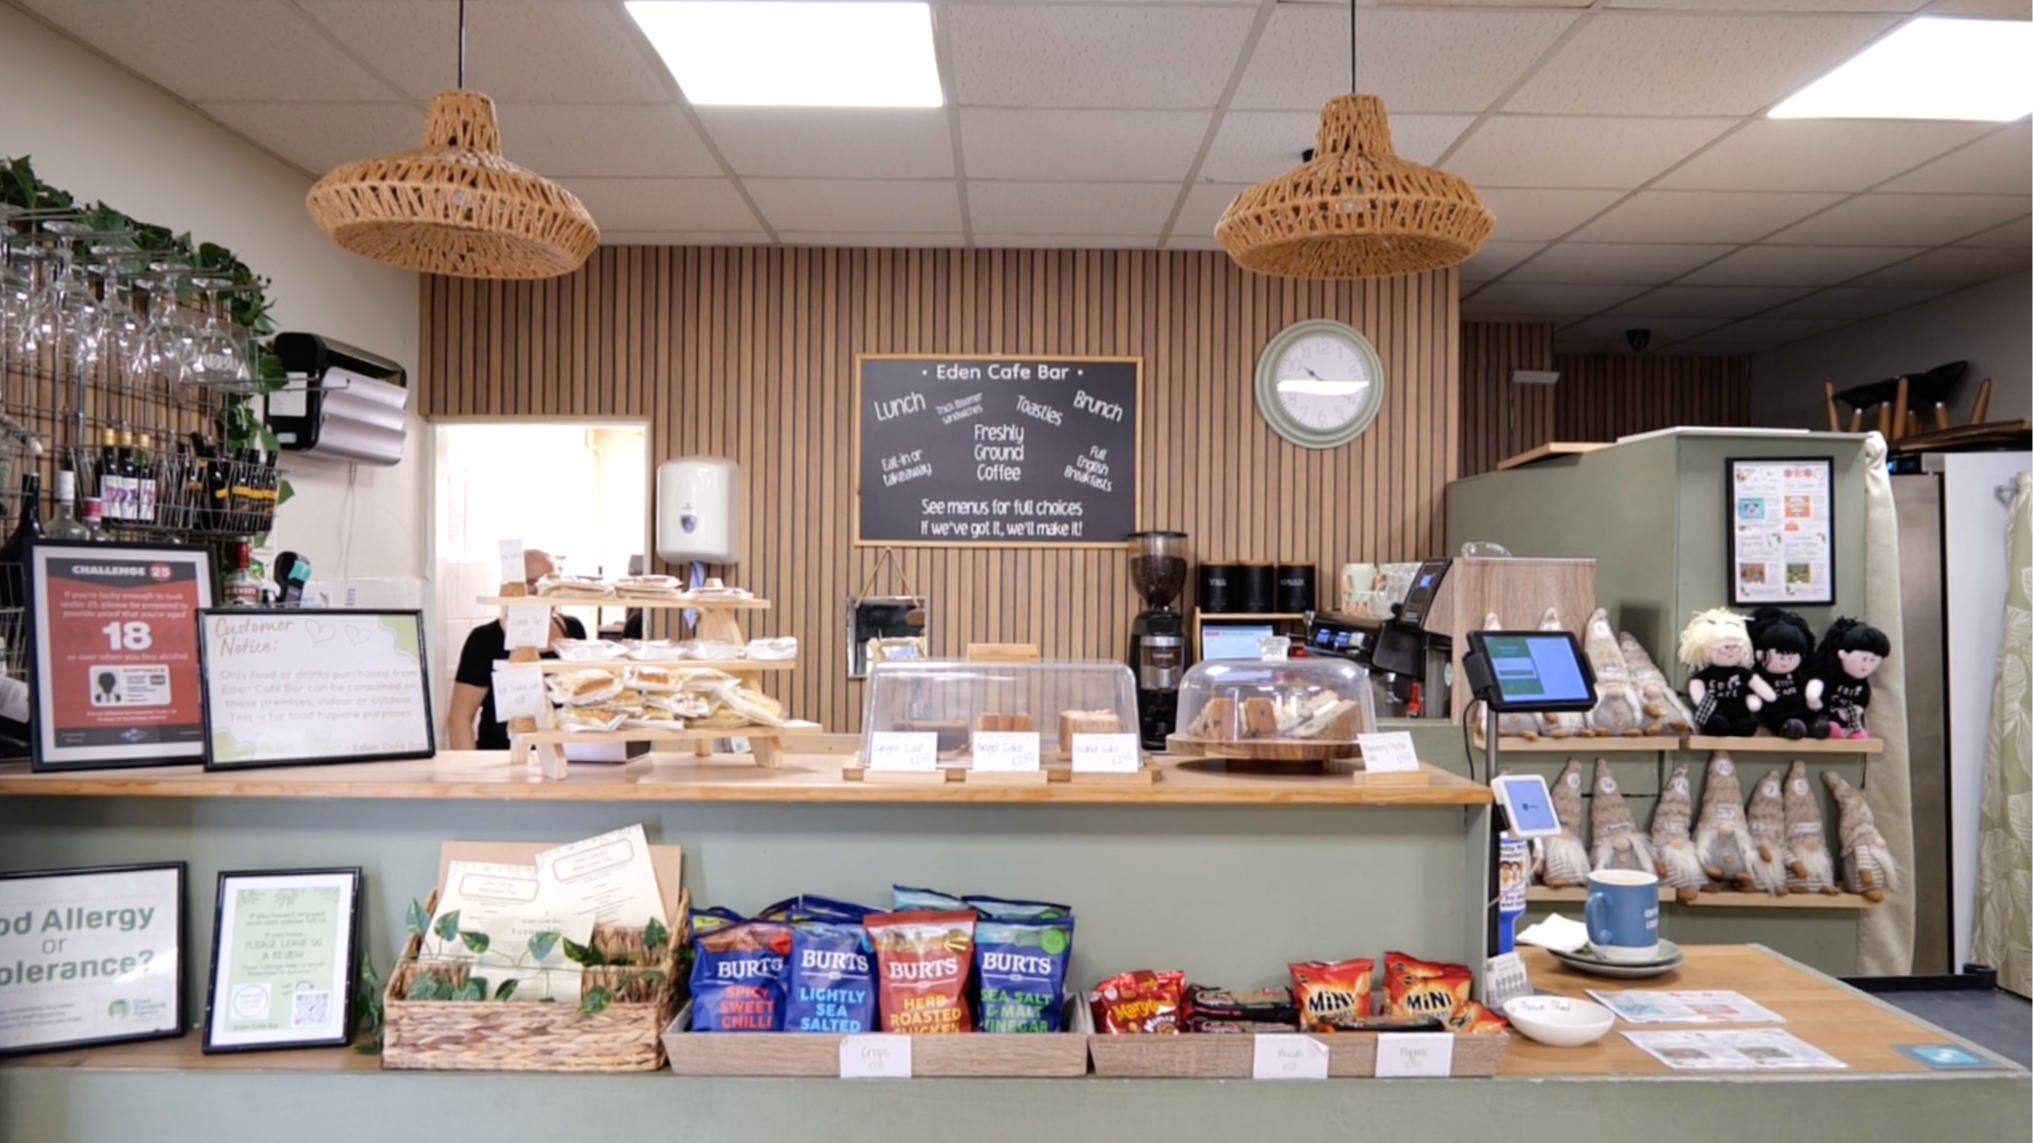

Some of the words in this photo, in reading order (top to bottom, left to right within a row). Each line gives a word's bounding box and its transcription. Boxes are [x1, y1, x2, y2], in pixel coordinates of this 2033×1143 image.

[936, 364, 981, 380] Eden
[988, 364, 1031, 380] Cafe
[1037, 364, 1070, 380] Bar
[874, 391, 926, 422] Lunch
[1016, 394, 1063, 426] Toasties
[1073, 390, 1123, 423] Brunch
[974, 424, 1025, 445] Freshly
[881, 452, 911, 472] Eat-in
[911, 449, 922, 462] or
[974, 444, 1025, 461] Ground
[1090, 445, 1107, 461] Full
[976, 464, 1021, 482] Coffee
[1076, 455, 1109, 476] English
[882, 462, 933, 488] takeaway
[1064, 465, 1113, 492] Breakfasts
[922, 499, 945, 515] See
[947, 500, 989, 516] menus
[992, 499, 1011, 515] for
[1014, 499, 1034, 515] full
[1036, 499, 1083, 516] choices
[921, 520, 929, 535] If
[931, 520, 968, 535] we've
[970, 521, 990, 539] got
[993, 521, 1004, 537] it,
[1007, 521, 1034, 536] we'll
[1037, 521, 1069, 536] make
[1071, 521, 1083, 537] it!
[71, 565, 146, 576] CHALLENGE
[151, 567, 171, 578] 25
[99, 591, 121, 601] lucky
[122, 592, 153, 602] enough
[155, 593, 164, 601] to
[165, 592, 183, 601] look
[60, 601, 85, 609] under
[101, 601, 128, 611] please
[130, 602, 140, 610] be
[142, 602, 178, 612] prepared
[63, 610, 95, 619] provide
[97, 610, 120, 619] proof
[121, 610, 139, 619] that
[166, 611, 187, 620] aged
[102, 621, 152, 650] 18
[215, 617, 293, 638] Customer
[220, 637, 278, 657] Notice:
[78, 654, 97, 662] over
[99, 653, 124, 661] when
[125, 654, 140, 662] you
[141, 653, 157, 662] buy
[159, 652, 189, 661] alcohol
[220, 670, 248, 682] Only
[251, 669, 277, 680] food
[280, 672, 292, 680] or
[295, 669, 330, 679] drinks
[333, 669, 389, 681] purchased
[392, 669, 418, 679] from
[221, 683, 251, 694] Eden
[254, 683, 281, 694] Cafe
[284, 682, 303, 693] Bar
[307, 684, 327, 693] can
[330, 682, 345, 692] be
[348, 682, 401, 692] consumed
[404, 683, 417, 691] on
[225, 698, 257, 708] these
[260, 698, 315, 710] premises,
[317, 697, 352, 707] indoor
[356, 698, 369, 706] or
[230, 712, 253, 723] This
[256, 713, 266, 723] is
[268, 712, 286, 722] for
[288, 711, 315, 721] food
[317, 709, 360, 722] hygiene
[352, 742, 380, 753] Eden
[382, 742, 408, 752] Cafe
[41, 907, 155, 932] Allergy
[42, 938, 67, 954] or
[245, 940, 276, 950] PLEASE
[281, 939, 307, 949] LEAVE
[272, 950, 305, 960] REVIEW
[801, 950, 869, 972] BURTS
[982, 952, 1051, 974] BURTS
[718, 957, 783, 978] BURTS
[889, 958, 958, 979] BURTS
[726, 985, 769, 998] SPICY
[801, 987, 866, 1004] LIGHTLY
[981, 989, 1007, 1002] SEA
[1015, 992, 1053, 1005] SALT
[719, 1000, 774, 1014] SWEET
[816, 1004, 847, 1017] SEA
[904, 995, 946, 1010] HERB
[890, 1007, 961, 1026] ROASTED
[986, 1005, 997, 1017] &
[1001, 1005, 1042, 1017] MALT
[720, 1015, 772, 1029] CHILLI
[801, 1017, 860, 1031] SALTED
